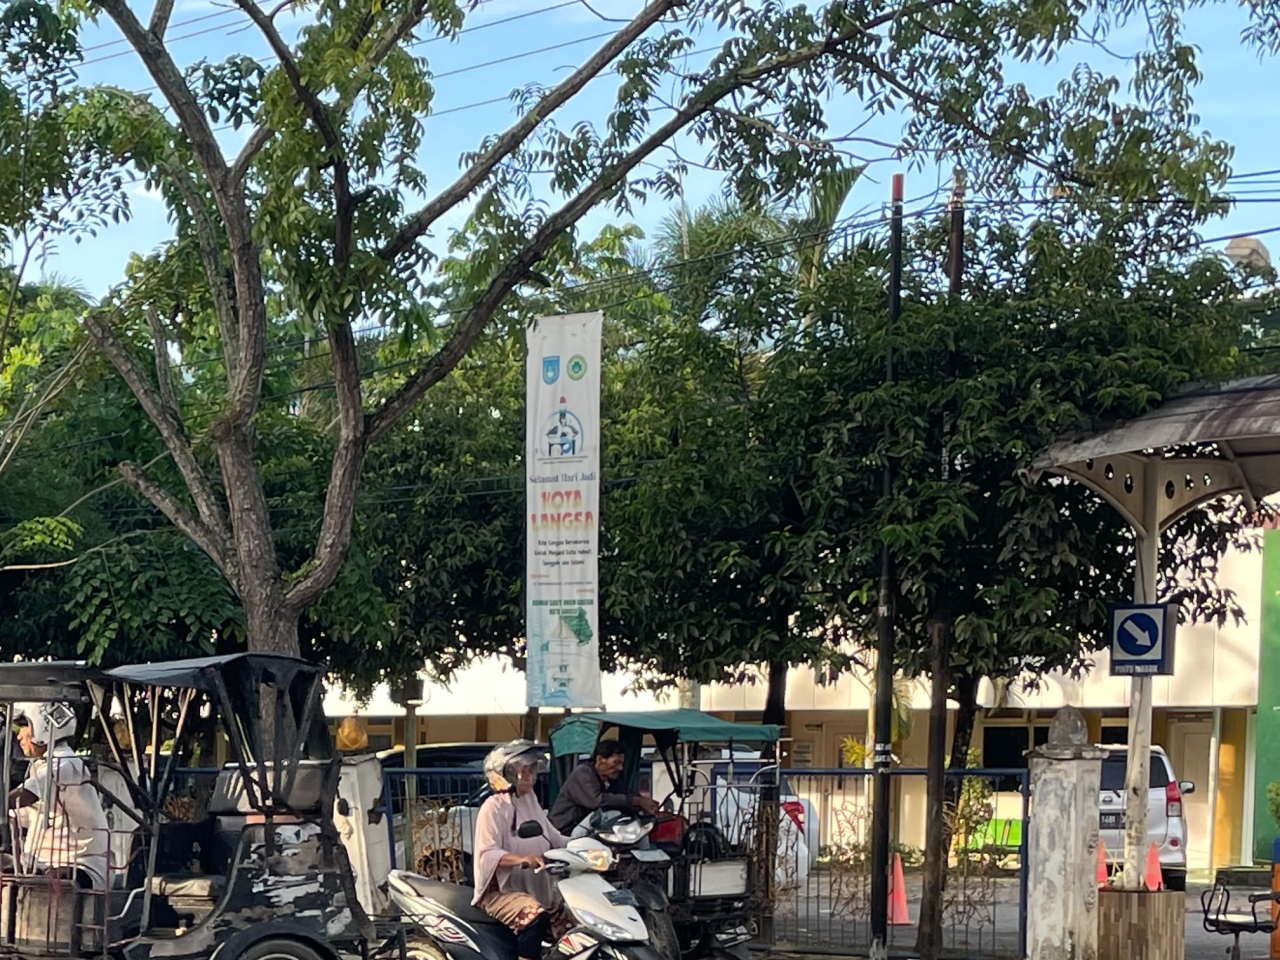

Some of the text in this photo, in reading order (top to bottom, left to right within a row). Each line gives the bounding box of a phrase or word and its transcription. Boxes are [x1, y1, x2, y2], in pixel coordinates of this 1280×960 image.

[529, 472, 596, 484] Selamat Hari Jadi
[541, 490, 582, 509] KOTA
[531, 511, 594, 532] LANGSA
